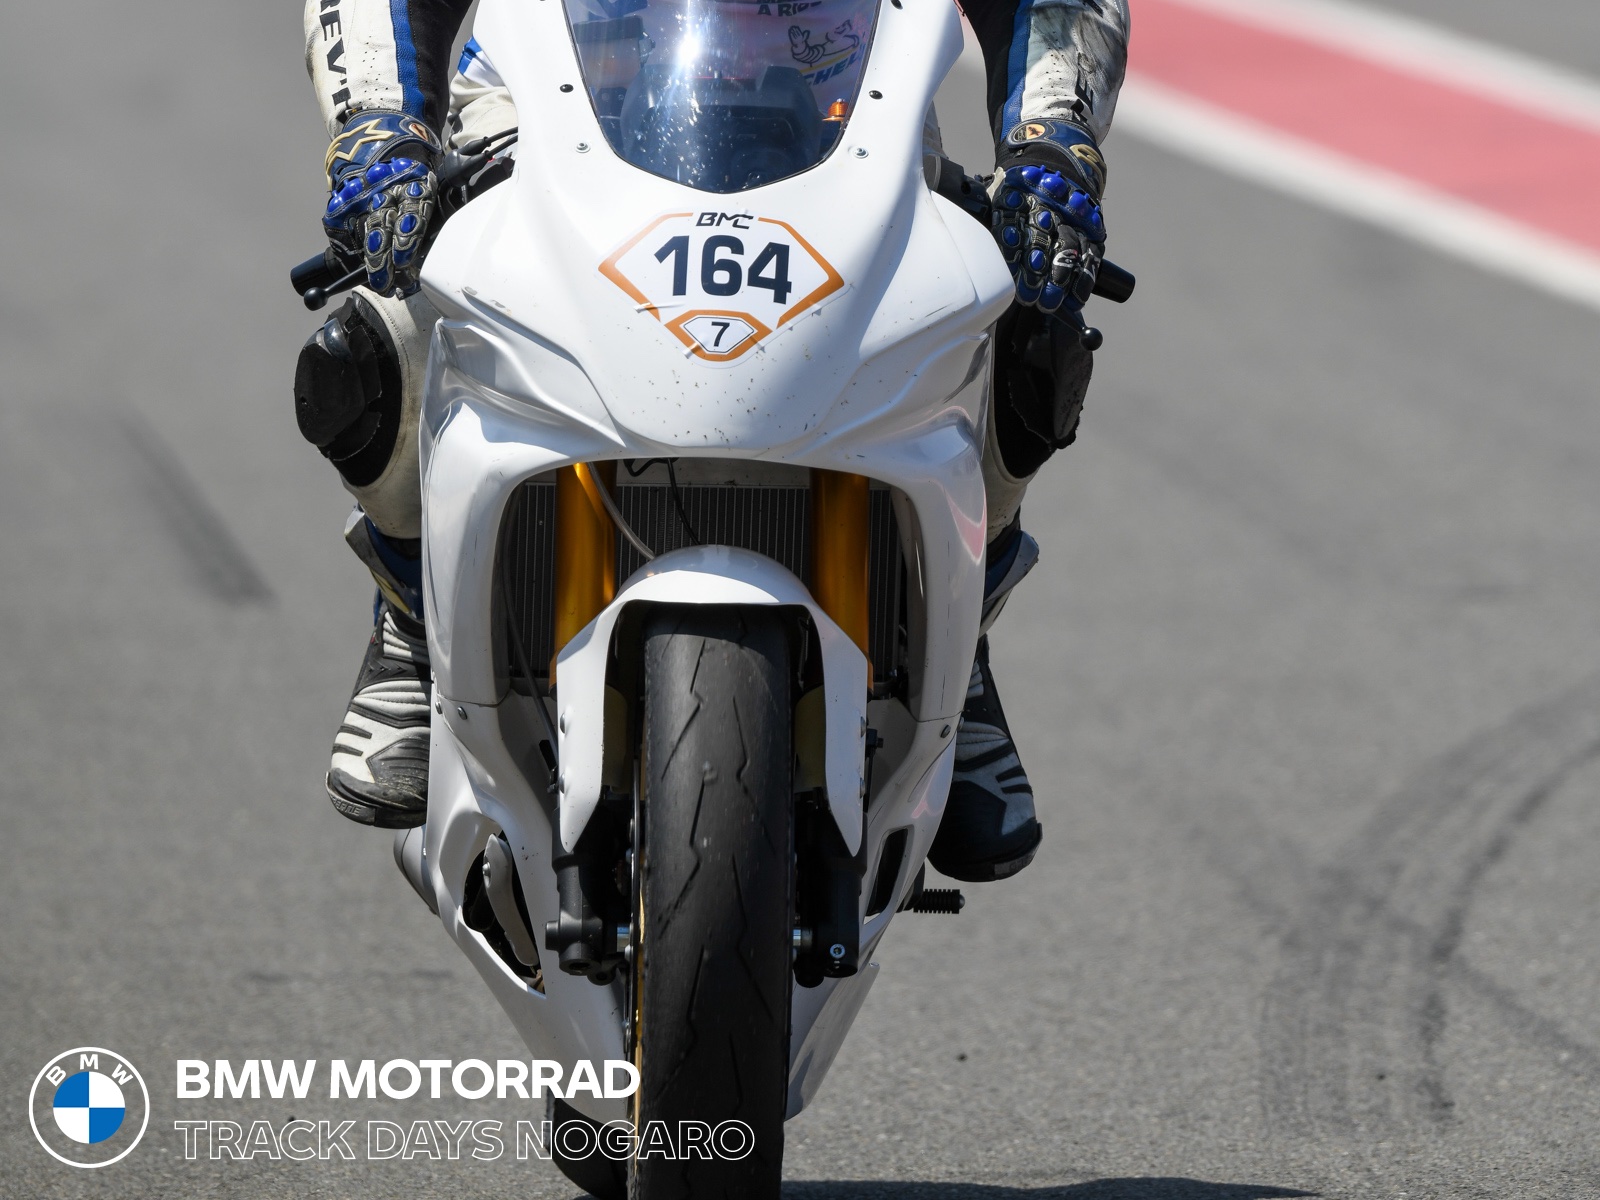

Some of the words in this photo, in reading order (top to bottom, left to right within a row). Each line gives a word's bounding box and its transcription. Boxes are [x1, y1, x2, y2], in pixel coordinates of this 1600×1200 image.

[757, 4, 772, 16] A
[695, 212, 755, 230] BMC
[653, 234, 792, 305] 164
[711, 321, 730, 348] 7
